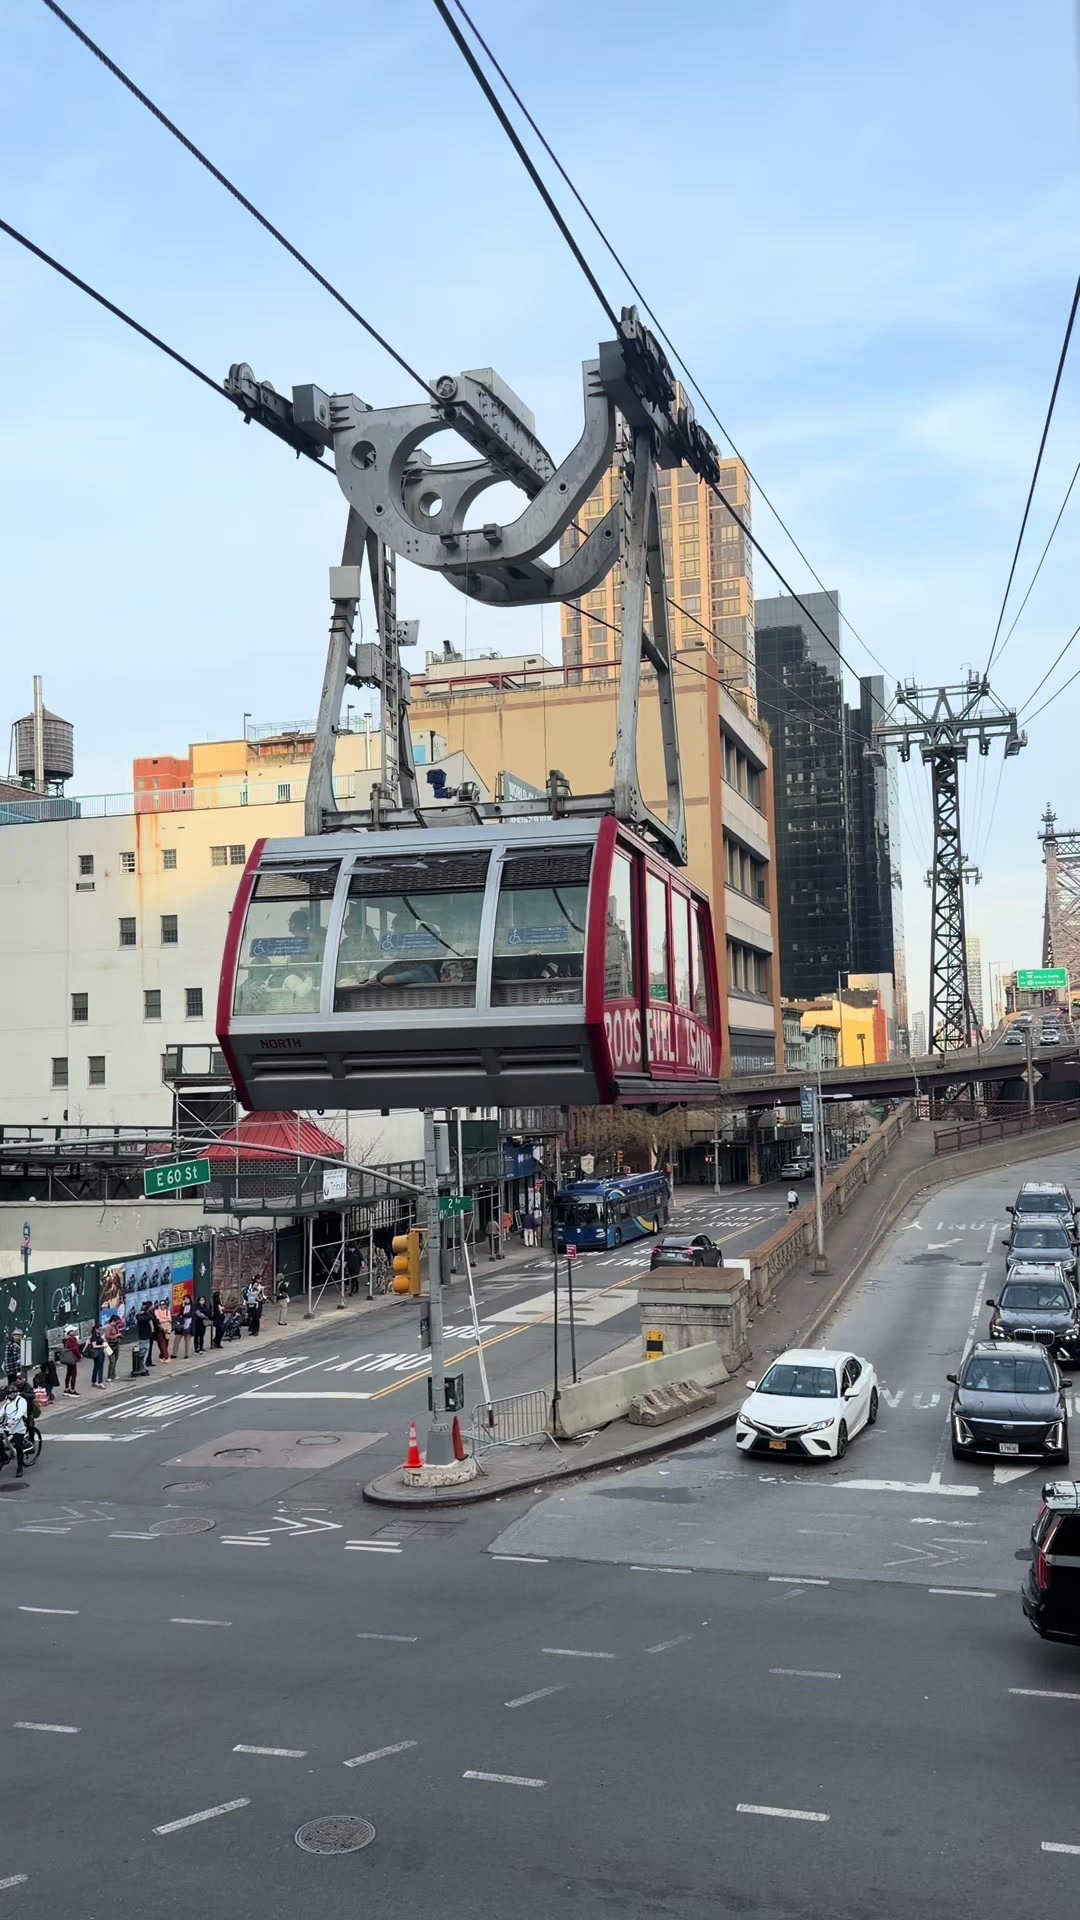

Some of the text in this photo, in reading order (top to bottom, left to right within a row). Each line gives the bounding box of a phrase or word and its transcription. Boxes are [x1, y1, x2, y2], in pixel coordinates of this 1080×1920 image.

[259, 1037, 302, 1049] NORTH
[156, 1165, 198, 1187] E 60 St
[447, 1198, 453, 1209] 2
[214, 1355, 310, 1375] BUS
[323, 1353, 432, 1372] ONLY
[75, 1394, 217, 1420] ONLY
